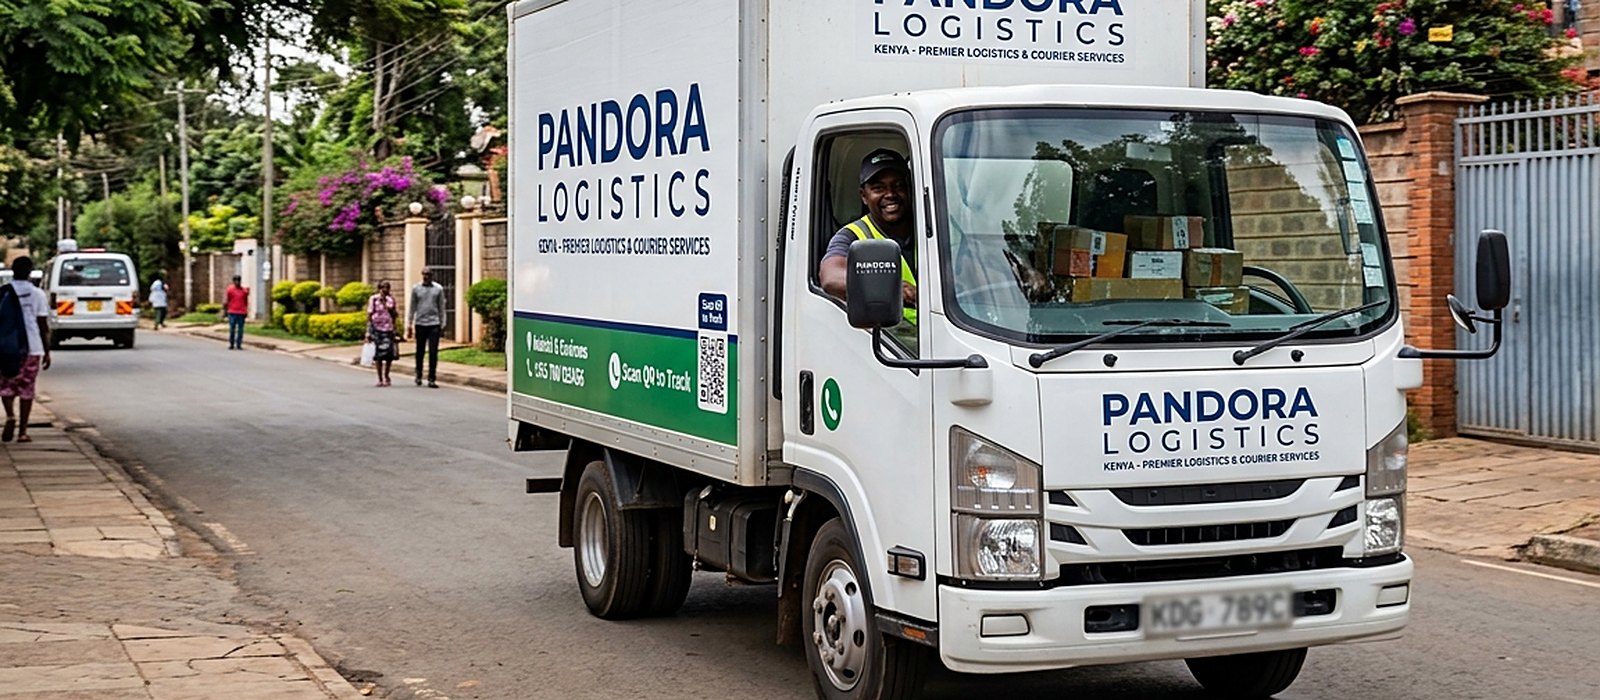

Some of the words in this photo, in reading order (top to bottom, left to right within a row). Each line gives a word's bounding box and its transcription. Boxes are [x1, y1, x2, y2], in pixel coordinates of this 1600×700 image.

[874, 12, 1125, 46] LOGISTICS
[874, 44, 909, 55] KENYA
[918, 45, 964, 57] PREMIER
[967, 47, 1020, 60] LOGISTICS
[1022, 50, 1028, 59] &
[1031, 50, 1075, 61] COURIER
[1077, 52, 1125, 63] SERVICES
[538, 83, 710, 170] PANDORA
[538, 168, 710, 222] LOGISTICS
[669, 237, 710, 255] SERVICES
[1102, 387, 1319, 425] PANDORA
[1103, 424, 1320, 454] LOGISTICS
[1103, 461, 1135, 471] KENYA
[1142, 458, 1183, 470] PREMIER
[1184, 456, 1230, 468] LOGISTICS
[1239, 454, 1278, 464] COURIER
[1279, 451, 1320, 462] SERVICES
